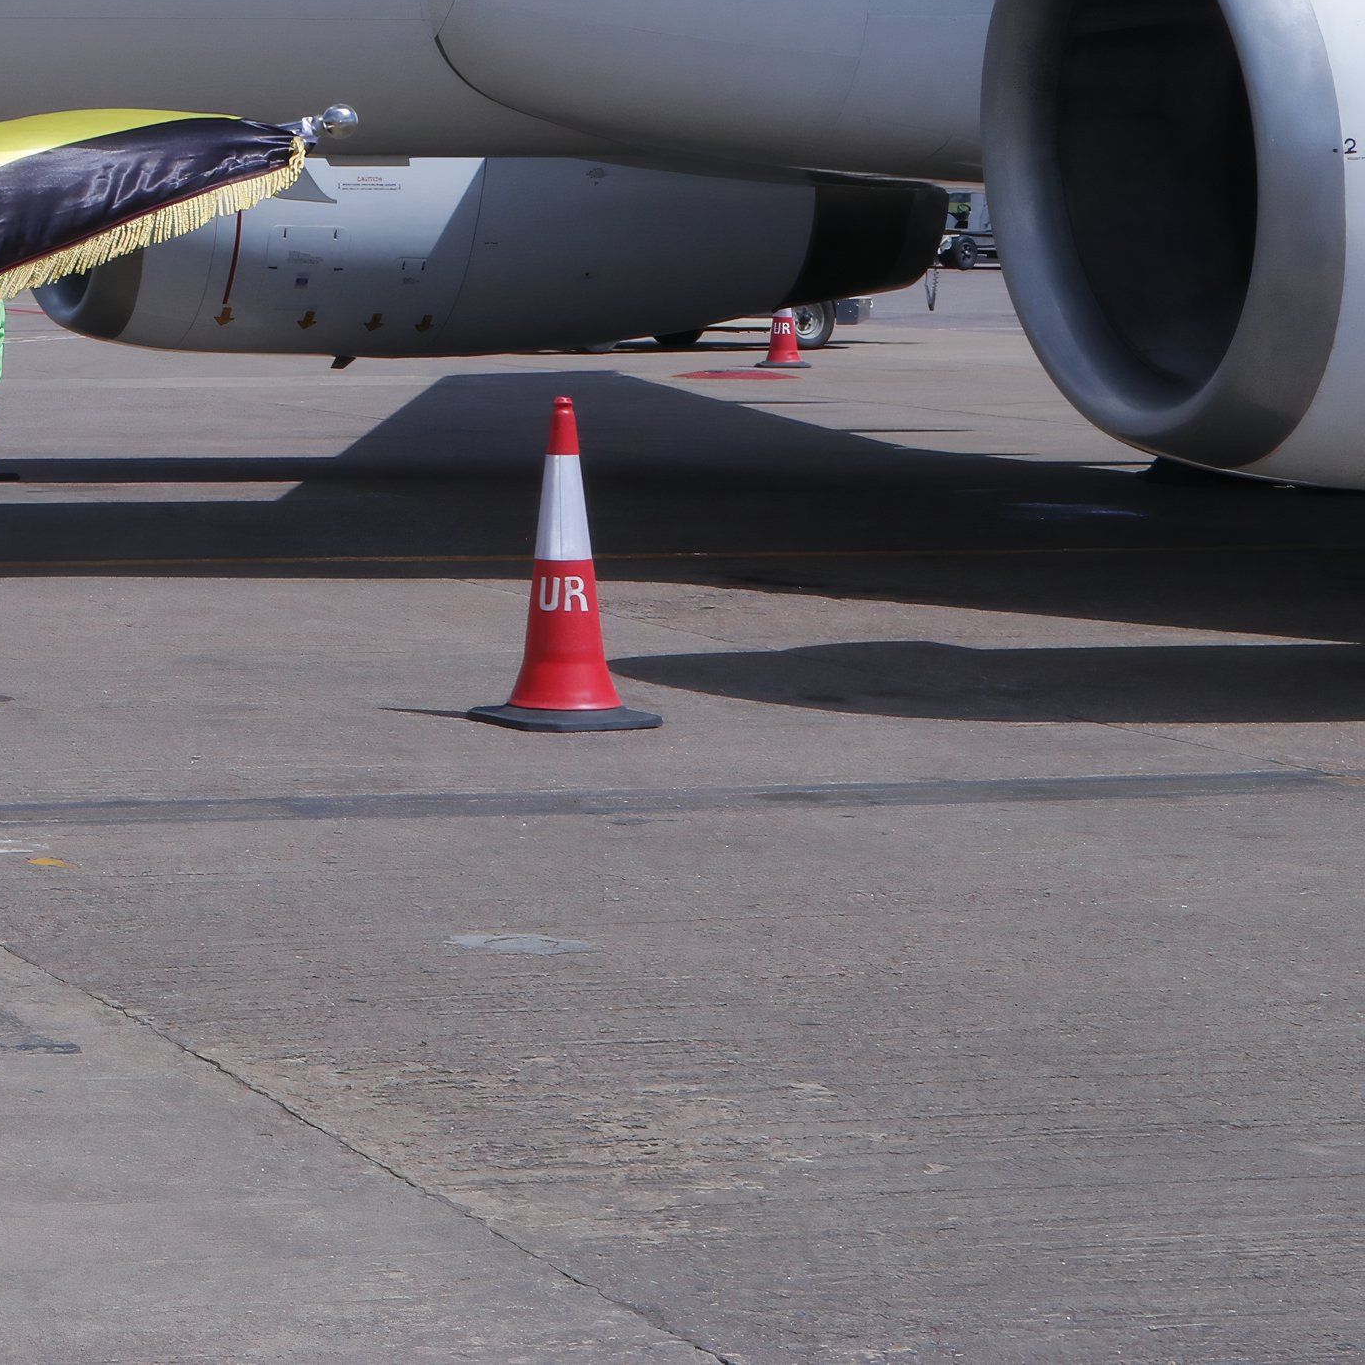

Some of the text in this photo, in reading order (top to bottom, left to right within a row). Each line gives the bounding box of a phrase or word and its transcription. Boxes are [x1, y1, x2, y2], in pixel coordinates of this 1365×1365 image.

[1344, 138, 1357, 154] 2
[773, 322, 791, 335] UR
[539, 576, 589, 612] UR
